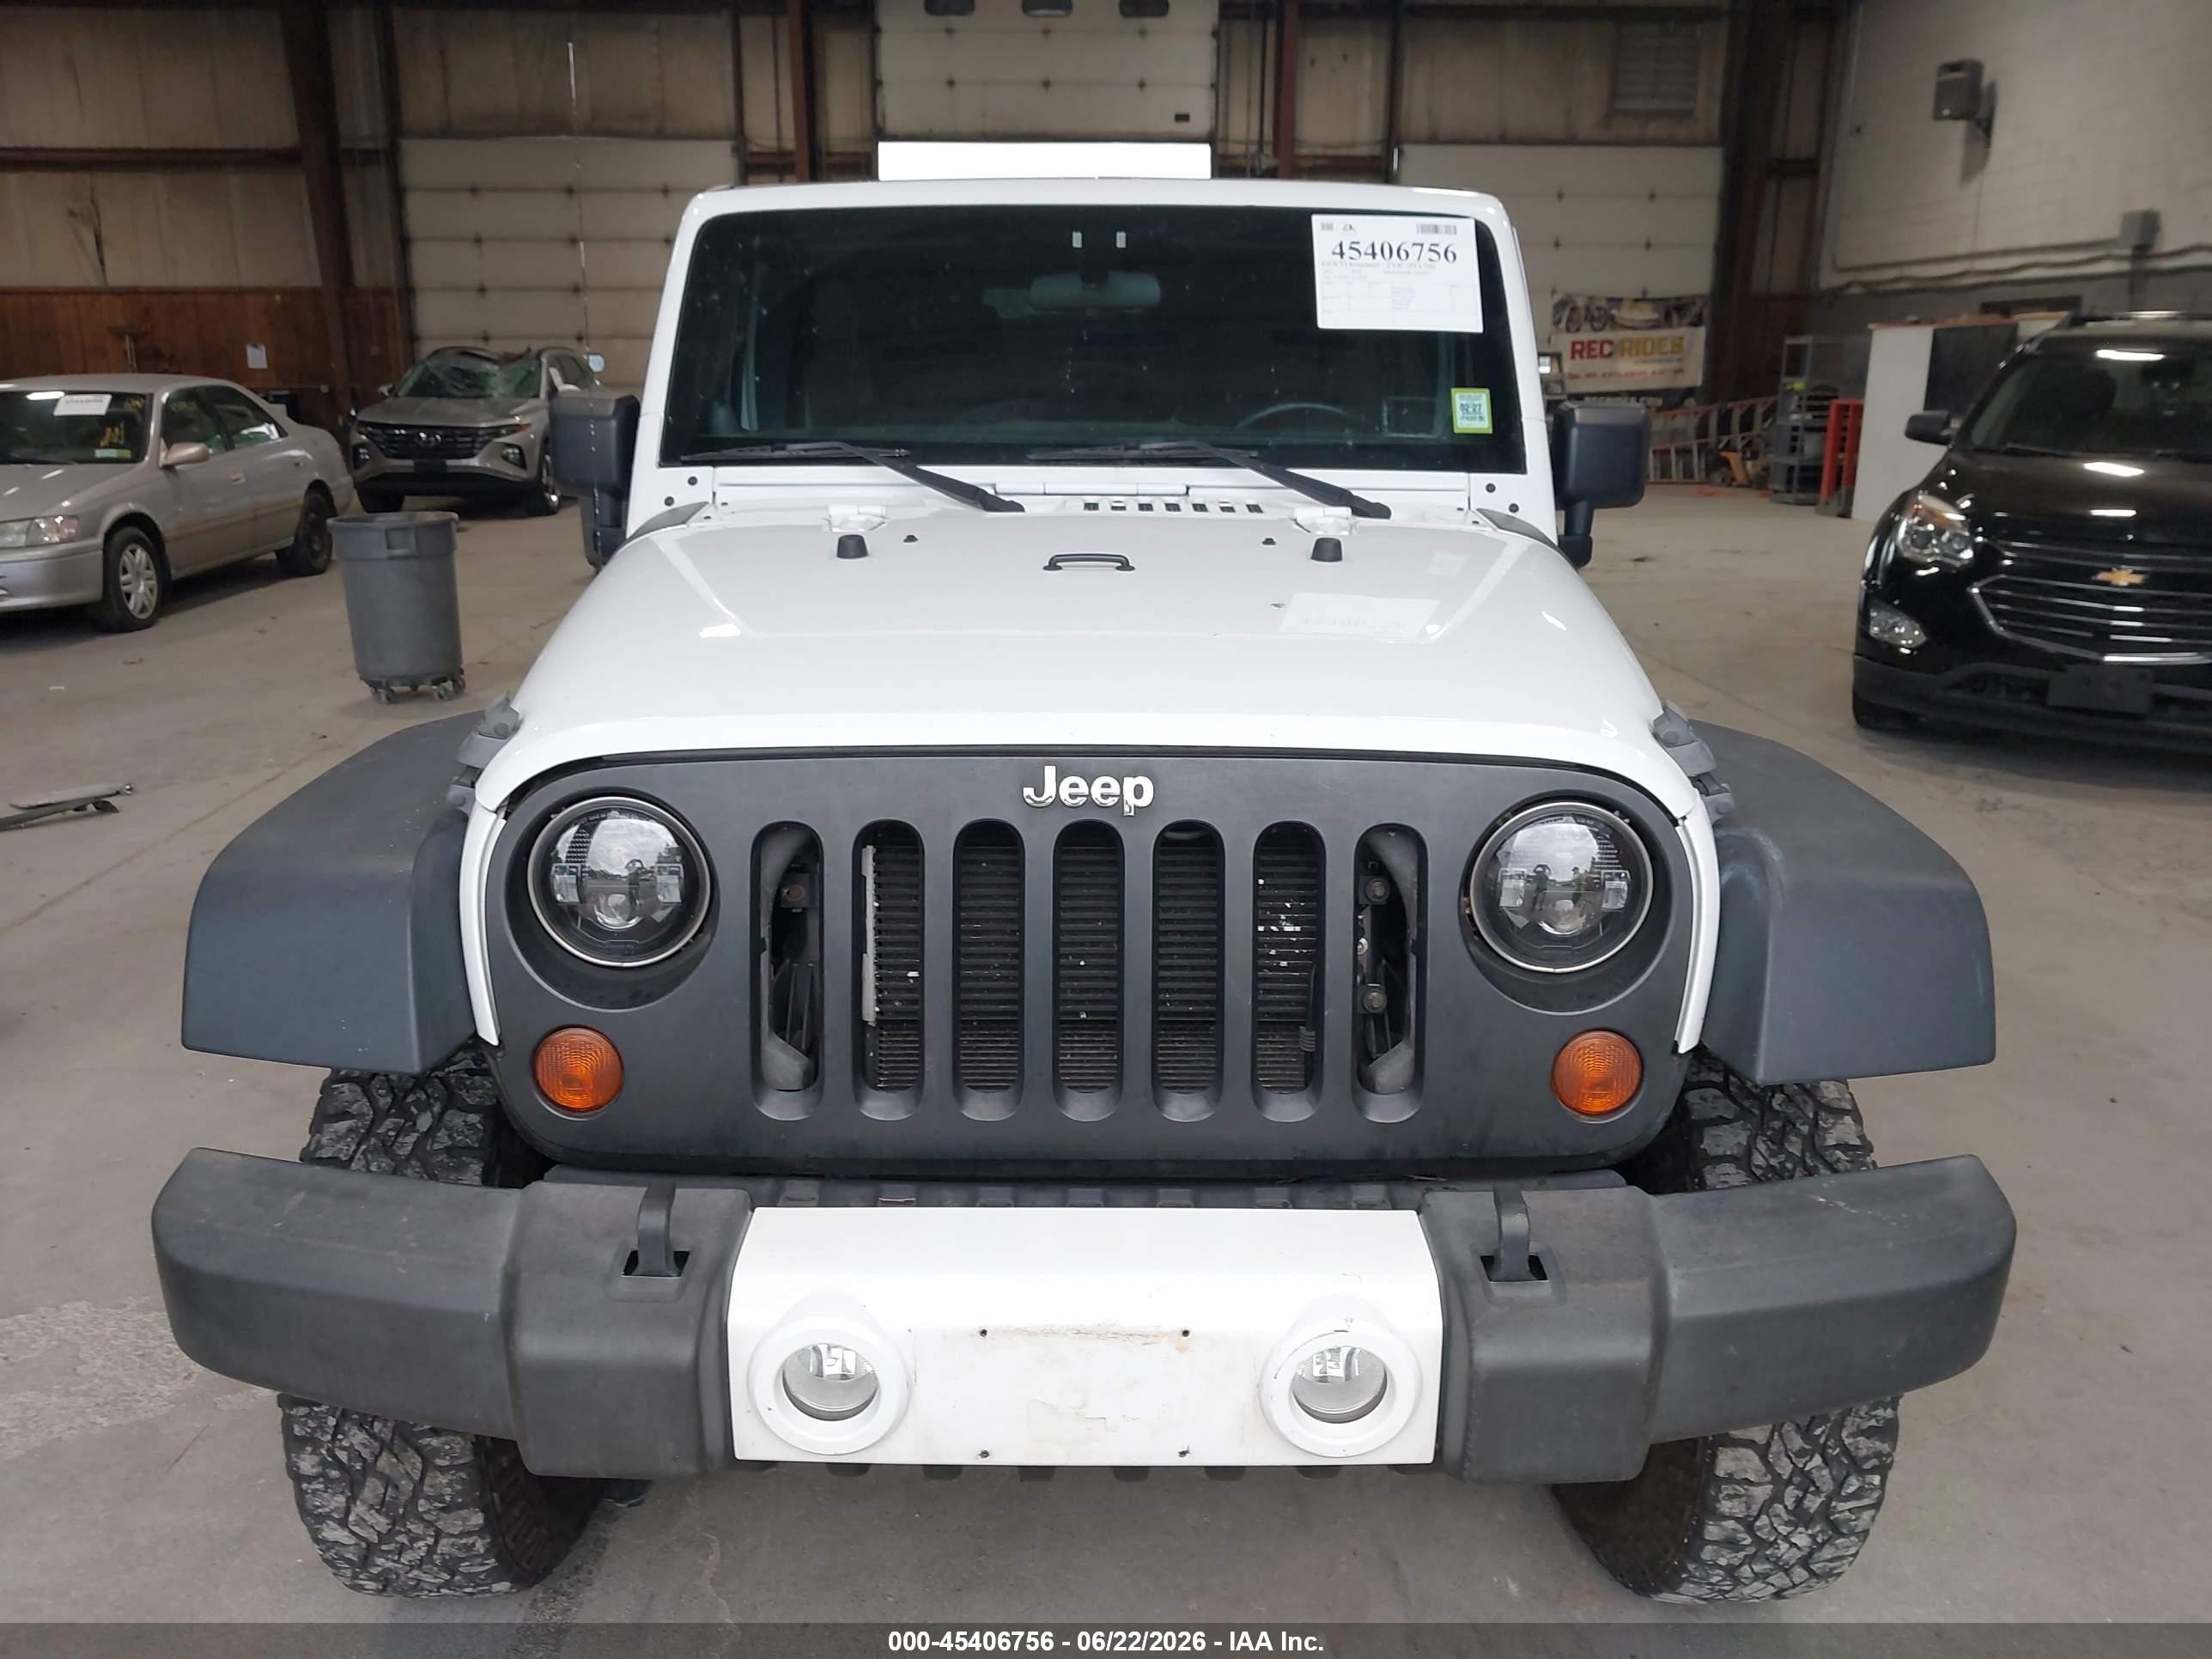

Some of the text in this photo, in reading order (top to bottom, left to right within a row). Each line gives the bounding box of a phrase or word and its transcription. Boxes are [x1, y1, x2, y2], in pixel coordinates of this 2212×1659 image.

[1332, 240, 1457, 263] 45406756
[1570, 336, 1684, 359] REC RIDES
[1023, 765, 1154, 817] Jeep
